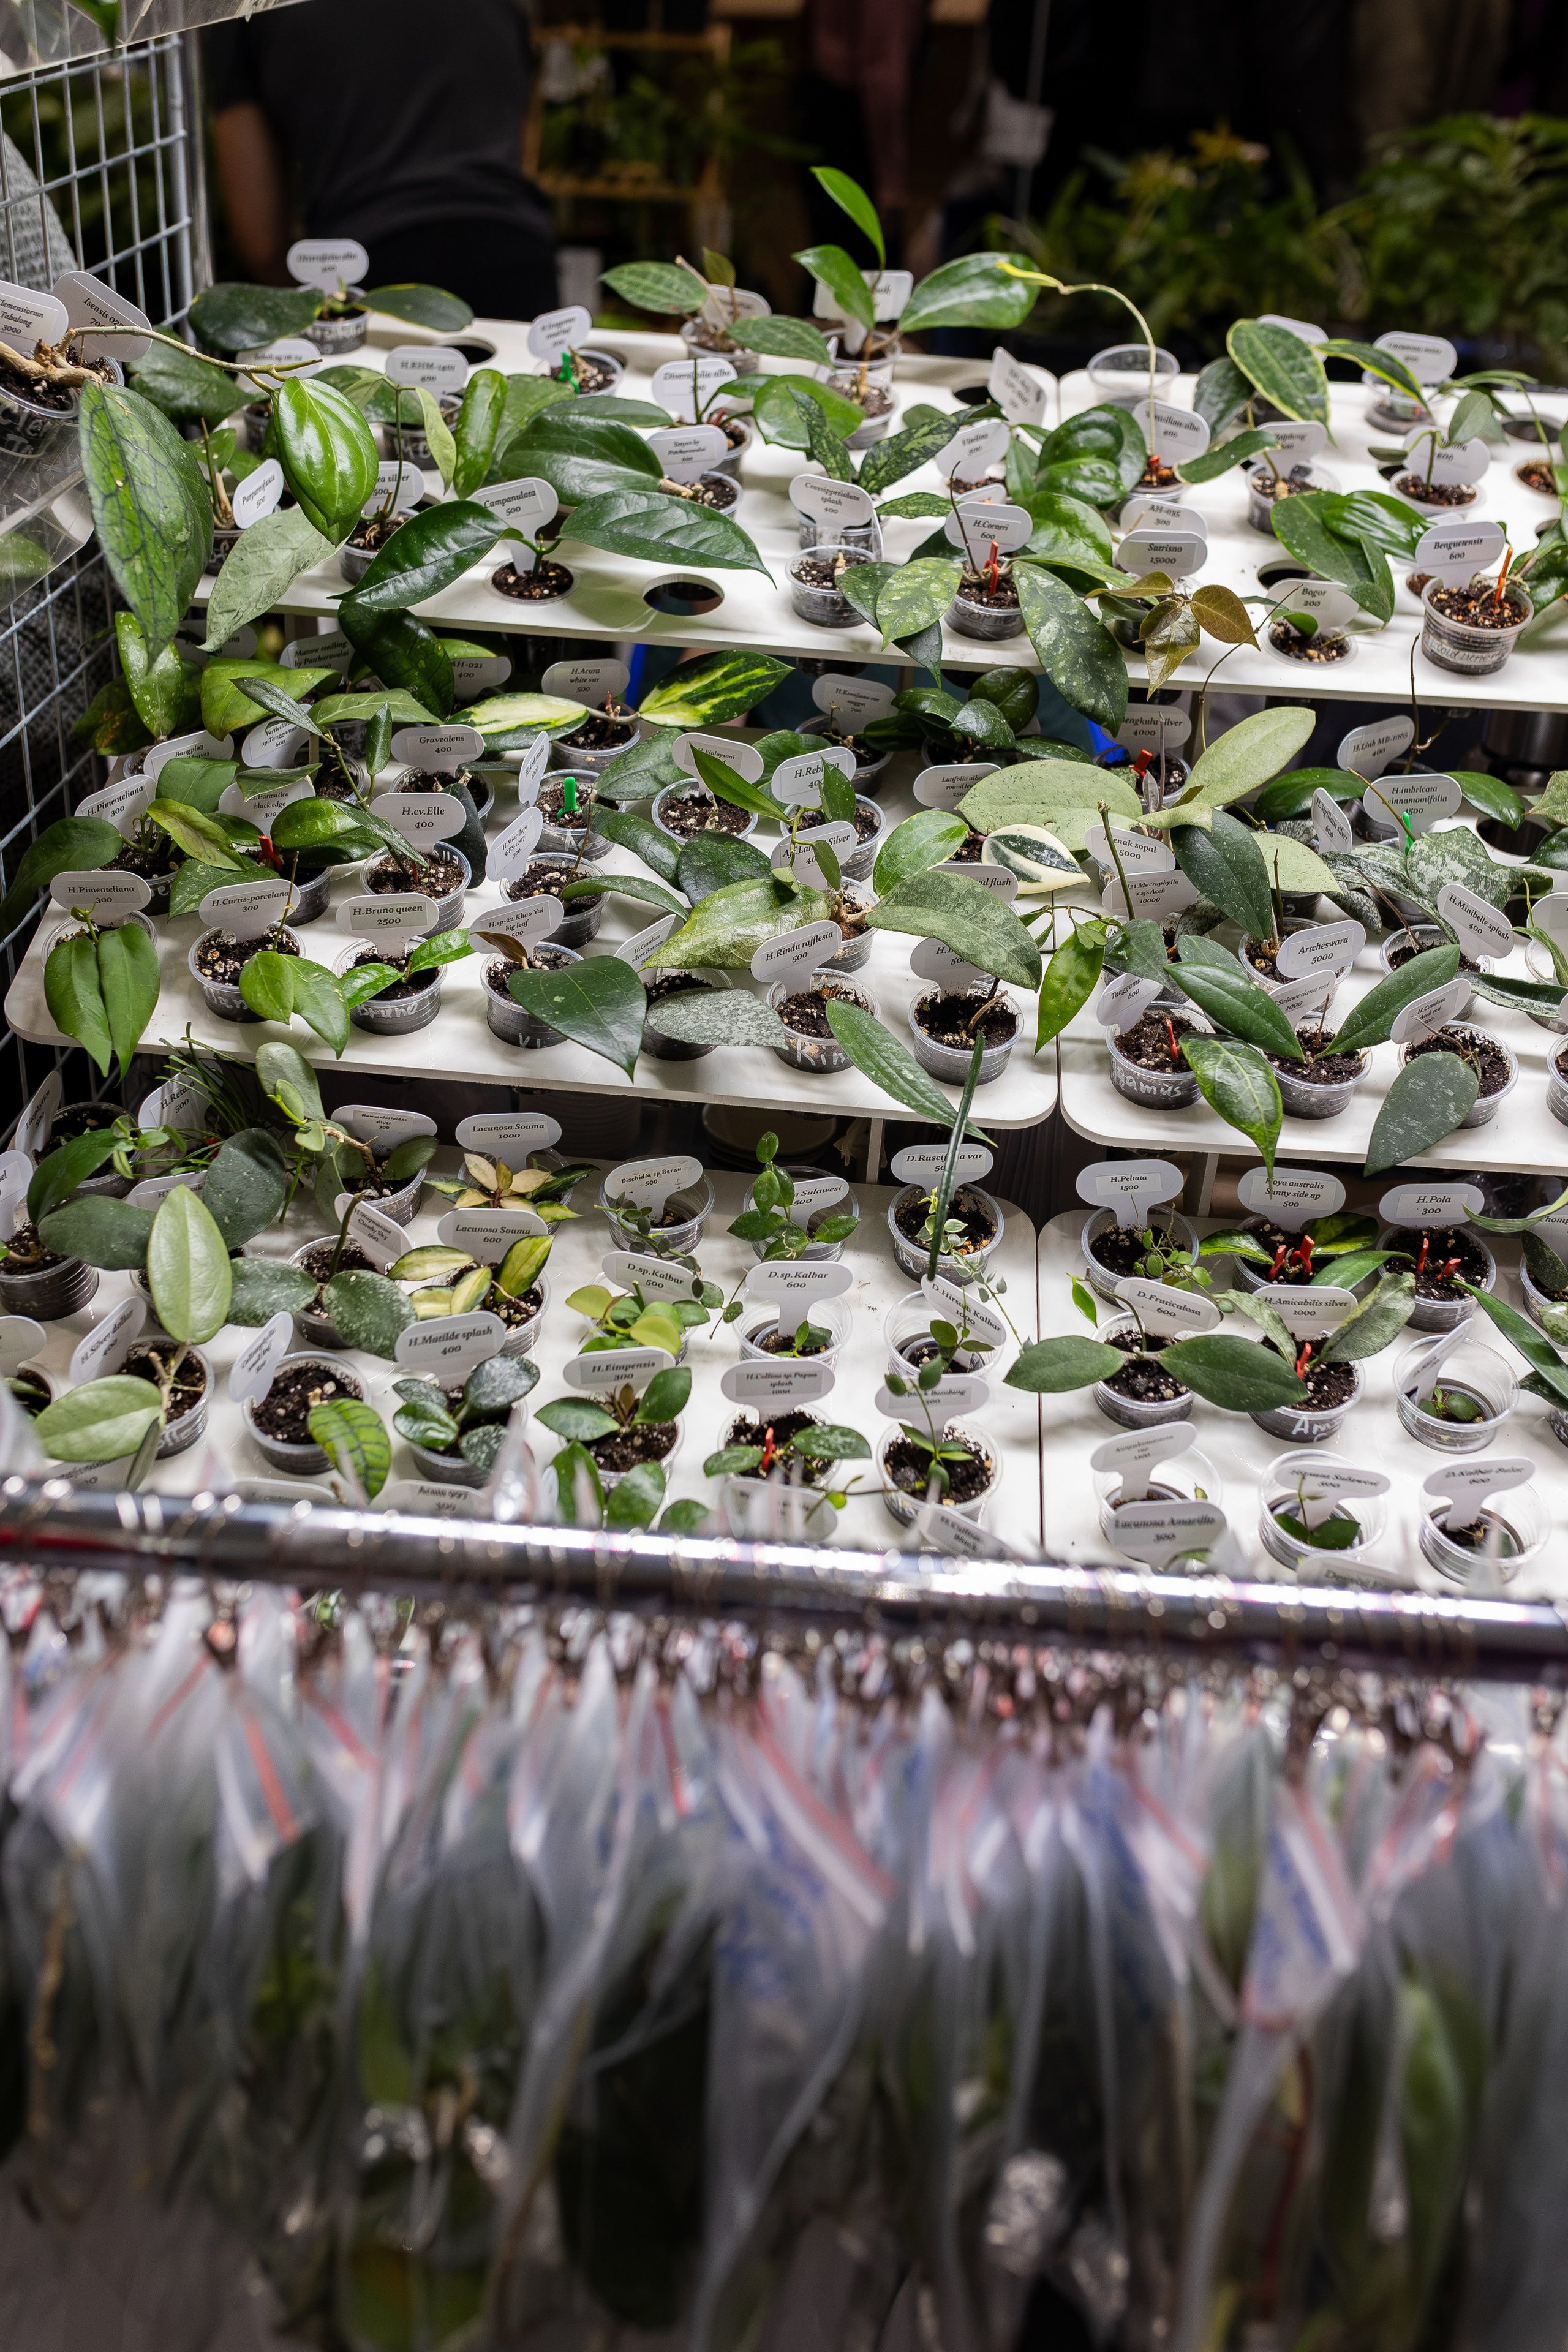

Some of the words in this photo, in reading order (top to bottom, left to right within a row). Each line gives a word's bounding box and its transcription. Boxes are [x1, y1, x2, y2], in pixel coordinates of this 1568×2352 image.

[82, 297, 110, 319] Isensis
[1, 311, 33, 328] Tabalong
[1, 324, 23, 334] 3000
[388, 473, 410, 483] siler
[484, 490, 537, 509] Campanulata
[505, 506, 521, 516] 500
[973, 519, 1010, 532] H.Corneri
[1433, 537, 1483, 551] Benguetensis
[1449, 551, 1466, 560] 600
[1302, 588, 1327, 598] Bogor
[1163, 717, 1183, 727] ilver
[274, 739, 286, 748] 600
[419, 734, 466, 745] Graveolens
[175, 744, 205, 758] Bangpla3
[1372, 748, 1386, 758] 400
[941, 776, 968, 786] Latifolia
[1391, 785, 1438, 794] H.imbricata
[86, 785, 145, 818] H.Pimenteliana
[254, 801, 271, 810] black
[110, 805, 126, 818] 300
[401, 806, 445, 816] H.cv.Elle
[1324, 824, 1335, 839] 600
[829, 834, 850, 847] Silver
[512, 848, 522, 859] 300
[1134, 842, 1158, 854] sopal
[805, 856, 816, 865] 40
[1118, 850, 1142, 860] 5000
[989, 877, 1012, 888] flush
[1137, 879, 1180, 889] Macrophylla
[67, 886, 135, 894] H.Pimenteliana
[1141, 888, 1166, 897] sp.Aceh
[211, 891, 290, 907] H.Curtis-porcelana
[242, 904, 260, 913] 300
[352, 908, 394, 916] H.Bruno
[397, 905, 423, 916] queen
[488, 917, 514, 929] H.sp-22
[514, 911, 533, 921] Khao
[533, 907, 545, 915] Yai
[1449, 894, 1489, 927] H.Minibelle
[1488, 919, 1510, 942] splash
[505, 923, 516, 932] big
[516, 919, 530, 929] leaf
[1468, 922, 1483, 935] 400
[765, 942, 801, 962] H.Rindu
[801, 930, 834, 949] rafflesia
[1297, 937, 1349, 956] Artcheswara
[631, 949, 647, 963] silver
[791, 951, 809, 963] 500
[1311, 952, 1335, 965] 5000
[1110, 978, 1144, 1000] Tanggamus
[1317, 981, 1331, 992] red
[1128, 988, 1140, 1000] 600
[1285, 1001, 1303, 1011] 1000
[1417, 997, 1446, 1015] H.Caudata
[1432, 1005, 1442, 1014] red
[160, 1081, 196, 1110] H.Retua
[175, 1098, 190, 1114] 500
[621, 1174, 653, 1185] Dischidia
[653, 1167, 682, 1177] sp.Berau
[1109, 1175, 1148, 1183] H.Peltata
[1288, 1178, 1324, 1189] australis
[801, 1185, 843, 1197] Sulawesi
[1292, 1189, 1309, 1199] side
[1310, 1192, 1321, 1201] up
[793, 1198, 813, 1207] 500
[1415, 1195, 1452, 1204] H.Pola
[1420, 1207, 1442, 1216] 300
[454, 1224, 498, 1234] Lacunosa
[499, 1226, 532, 1235] Souma
[627, 1262, 685, 1285] D.sp.Kalbar
[767, 1271, 829, 1280] D.sp.Kalbar
[645, 1278, 665, 1289] 500
[1137, 1290, 1201, 1316] D.Fruticulosa
[1264, 1297, 1324, 1307] H.Amicabilis
[1324, 1299, 1349, 1308] silver
[1156, 1307, 1177, 1317] 600
[973, 1309, 1002, 1333] Kalbar
[409, 1332, 460, 1348] H.Matilde
[461, 1325, 493, 1340] splash
[440, 1345, 462, 1356] 400
